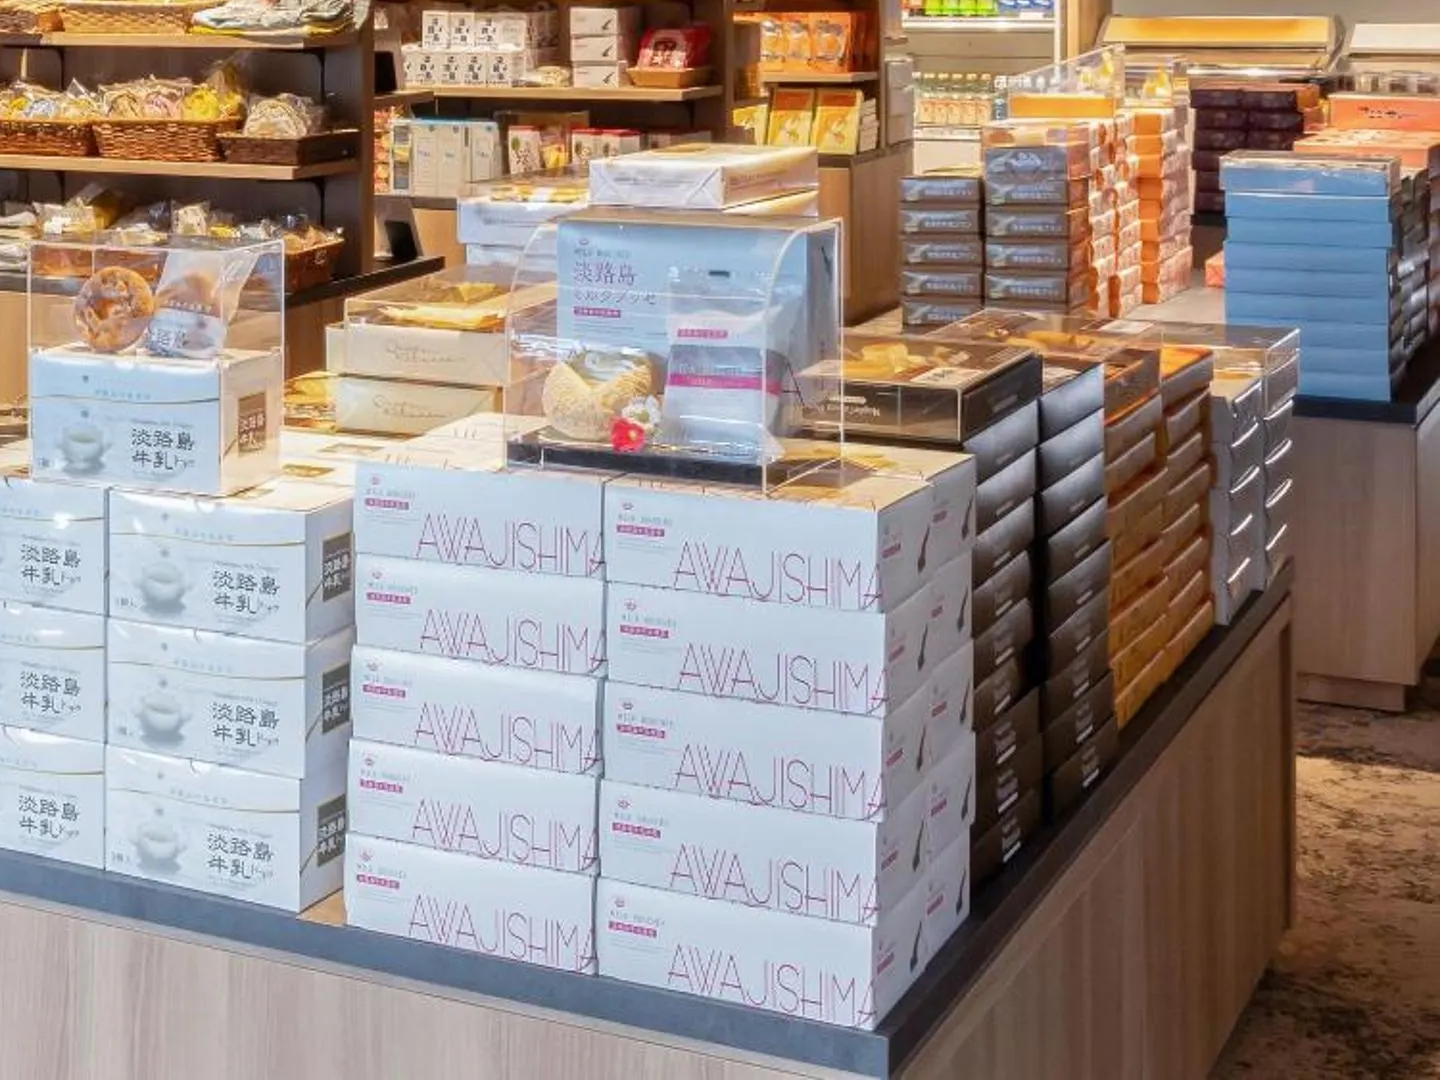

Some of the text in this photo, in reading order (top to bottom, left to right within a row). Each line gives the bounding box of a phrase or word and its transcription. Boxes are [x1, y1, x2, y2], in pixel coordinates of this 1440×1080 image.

[131, 427, 196, 453] 淡路島
[20, 543, 82, 569] 淡路島
[213, 570, 280, 595] 淡路島
[19, 671, 81, 697] 淡路島
[213, 702, 279, 729] 淡路島
[19, 795, 80, 822] 淡路島
[208, 832, 274, 861] 淡路島
